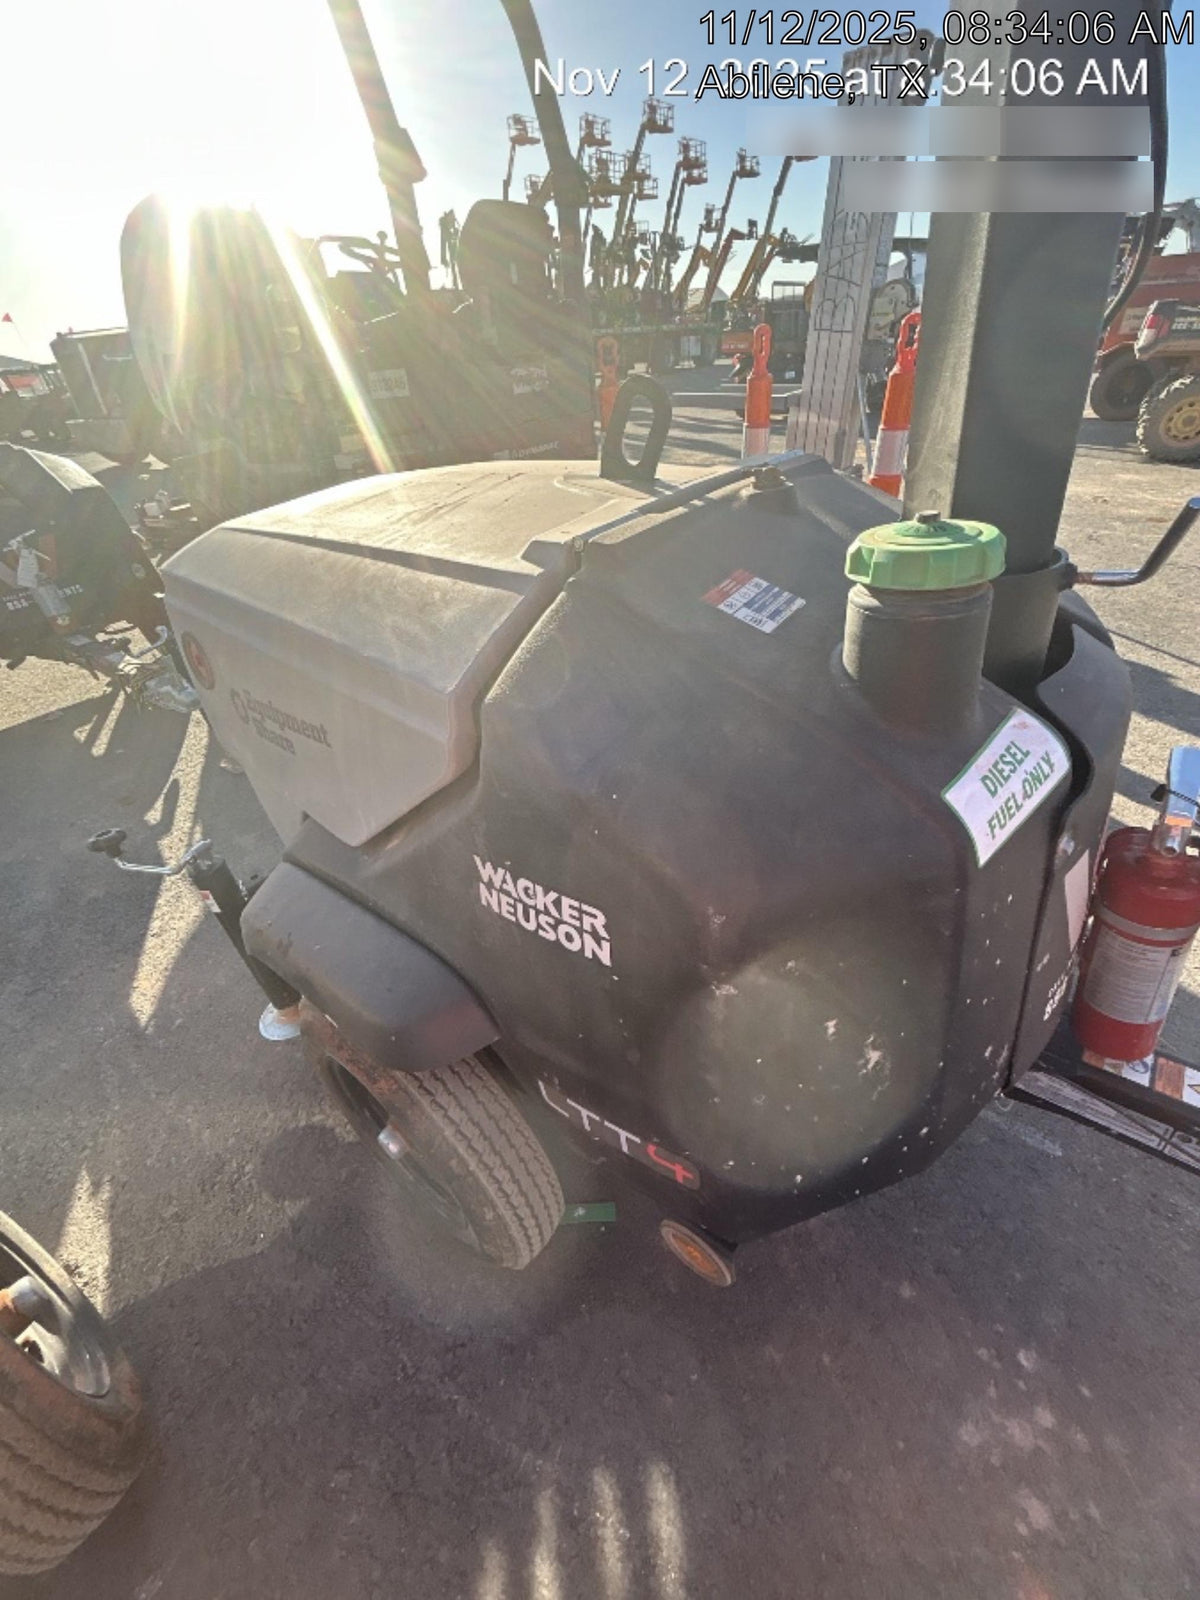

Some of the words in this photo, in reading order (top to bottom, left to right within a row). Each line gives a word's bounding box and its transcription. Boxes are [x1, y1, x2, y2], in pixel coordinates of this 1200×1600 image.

[980, 741, 1030, 798] DIESEL
[987, 792, 1024, 840] FUEL
[1021, 750, 1056, 801] ONLY
[473, 854, 610, 940] WACKER
[479, 882, 612, 968] NEUSON
